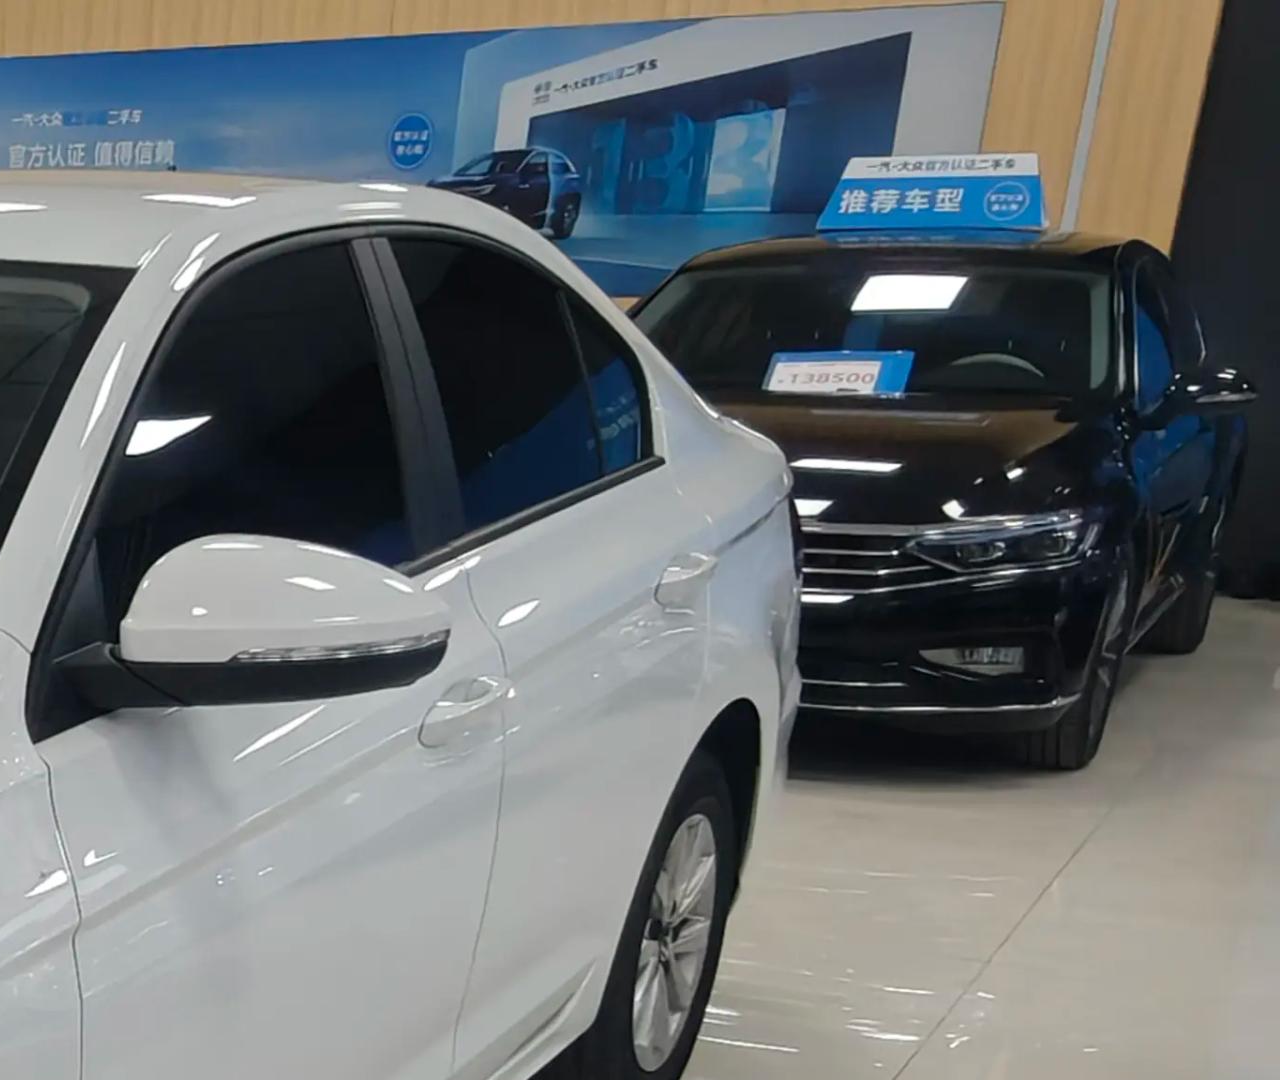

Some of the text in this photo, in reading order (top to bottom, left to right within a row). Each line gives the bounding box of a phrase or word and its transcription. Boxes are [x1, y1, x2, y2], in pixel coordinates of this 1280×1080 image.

[8, 139, 175, 168] 官方认证 值得信赖
[838, 187, 964, 215] 推荐车型
